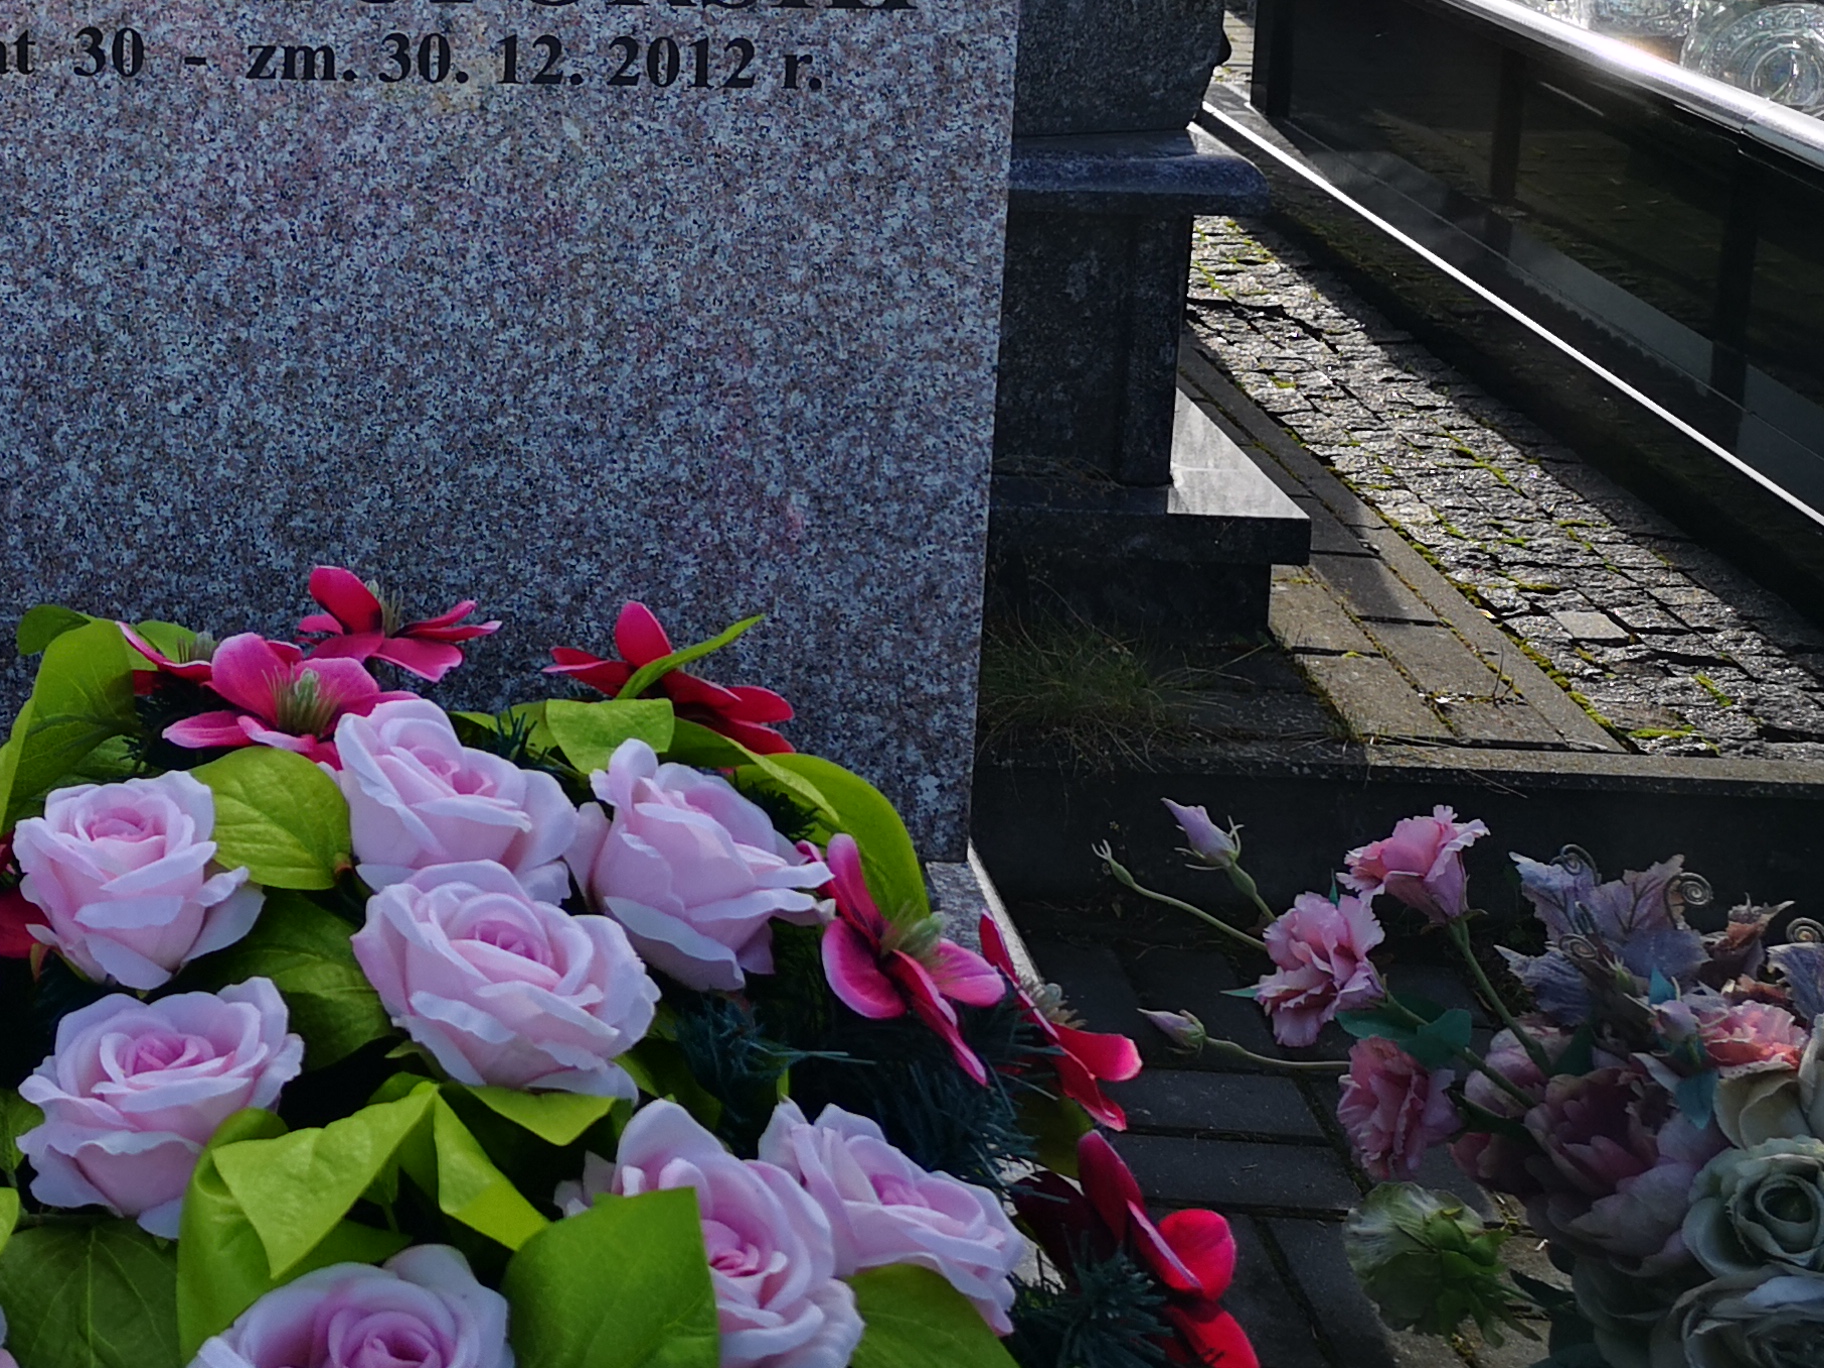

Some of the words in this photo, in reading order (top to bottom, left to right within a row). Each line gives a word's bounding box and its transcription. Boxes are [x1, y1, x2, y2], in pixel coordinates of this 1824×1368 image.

[75, 26, 146, 78] 30
[246, 42, 358, 82] zm.
[377, 32, 470, 86] 30.
[497, 34, 585, 87] 12.
[606, 35, 756, 91] 2012
[782, 51, 824, 92] r.
